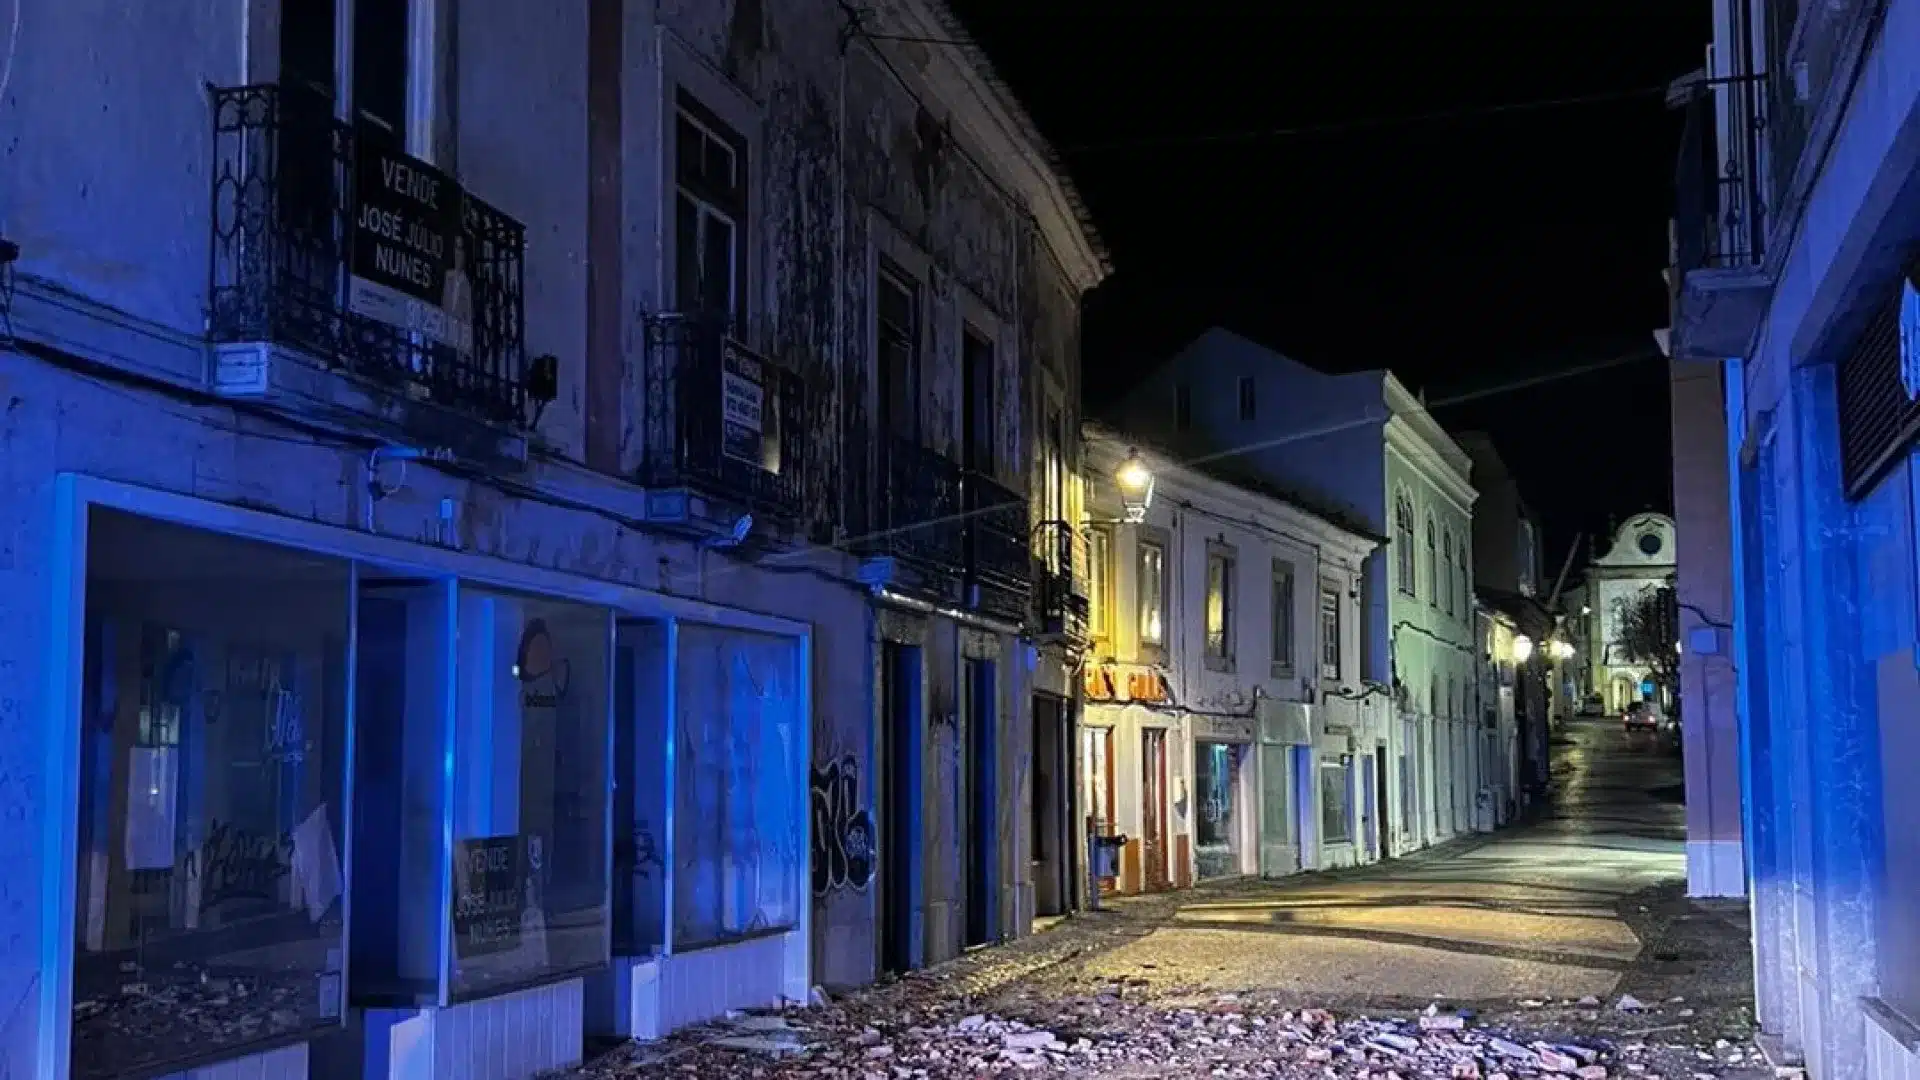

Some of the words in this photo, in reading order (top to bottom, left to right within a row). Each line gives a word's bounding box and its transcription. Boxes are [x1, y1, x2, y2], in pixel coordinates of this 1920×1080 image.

[381, 156, 440, 211] VENDE
[358, 202, 403, 242] JOSÉ
[375, 242, 433, 288] NUNES
